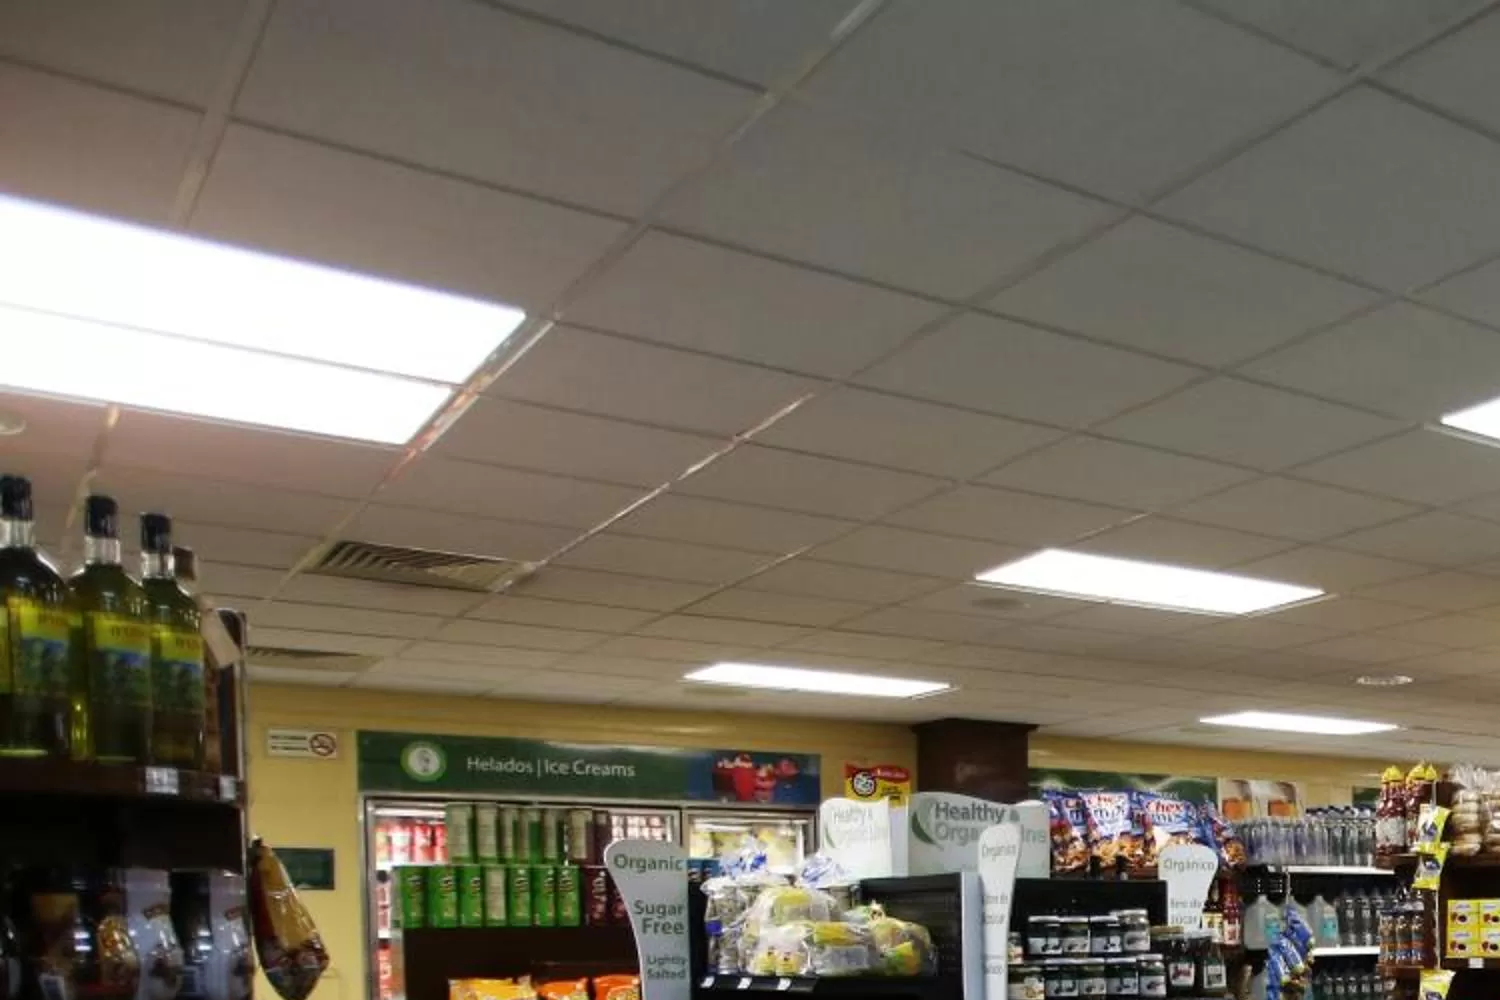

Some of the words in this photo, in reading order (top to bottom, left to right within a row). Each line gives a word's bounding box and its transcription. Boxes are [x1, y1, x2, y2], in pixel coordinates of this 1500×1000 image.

[467, 756, 533, 774] Helados
[544, 758, 570, 775] Ice
[572, 759, 637, 778] Creams
[935, 801, 1005, 824] Healthy
[613, 853, 684, 873] Organic
[633, 899, 685, 918] Sugar
[641, 918, 685, 935] Free
[647, 954, 687, 967] Lightly
[647, 967, 687, 980] Salted
